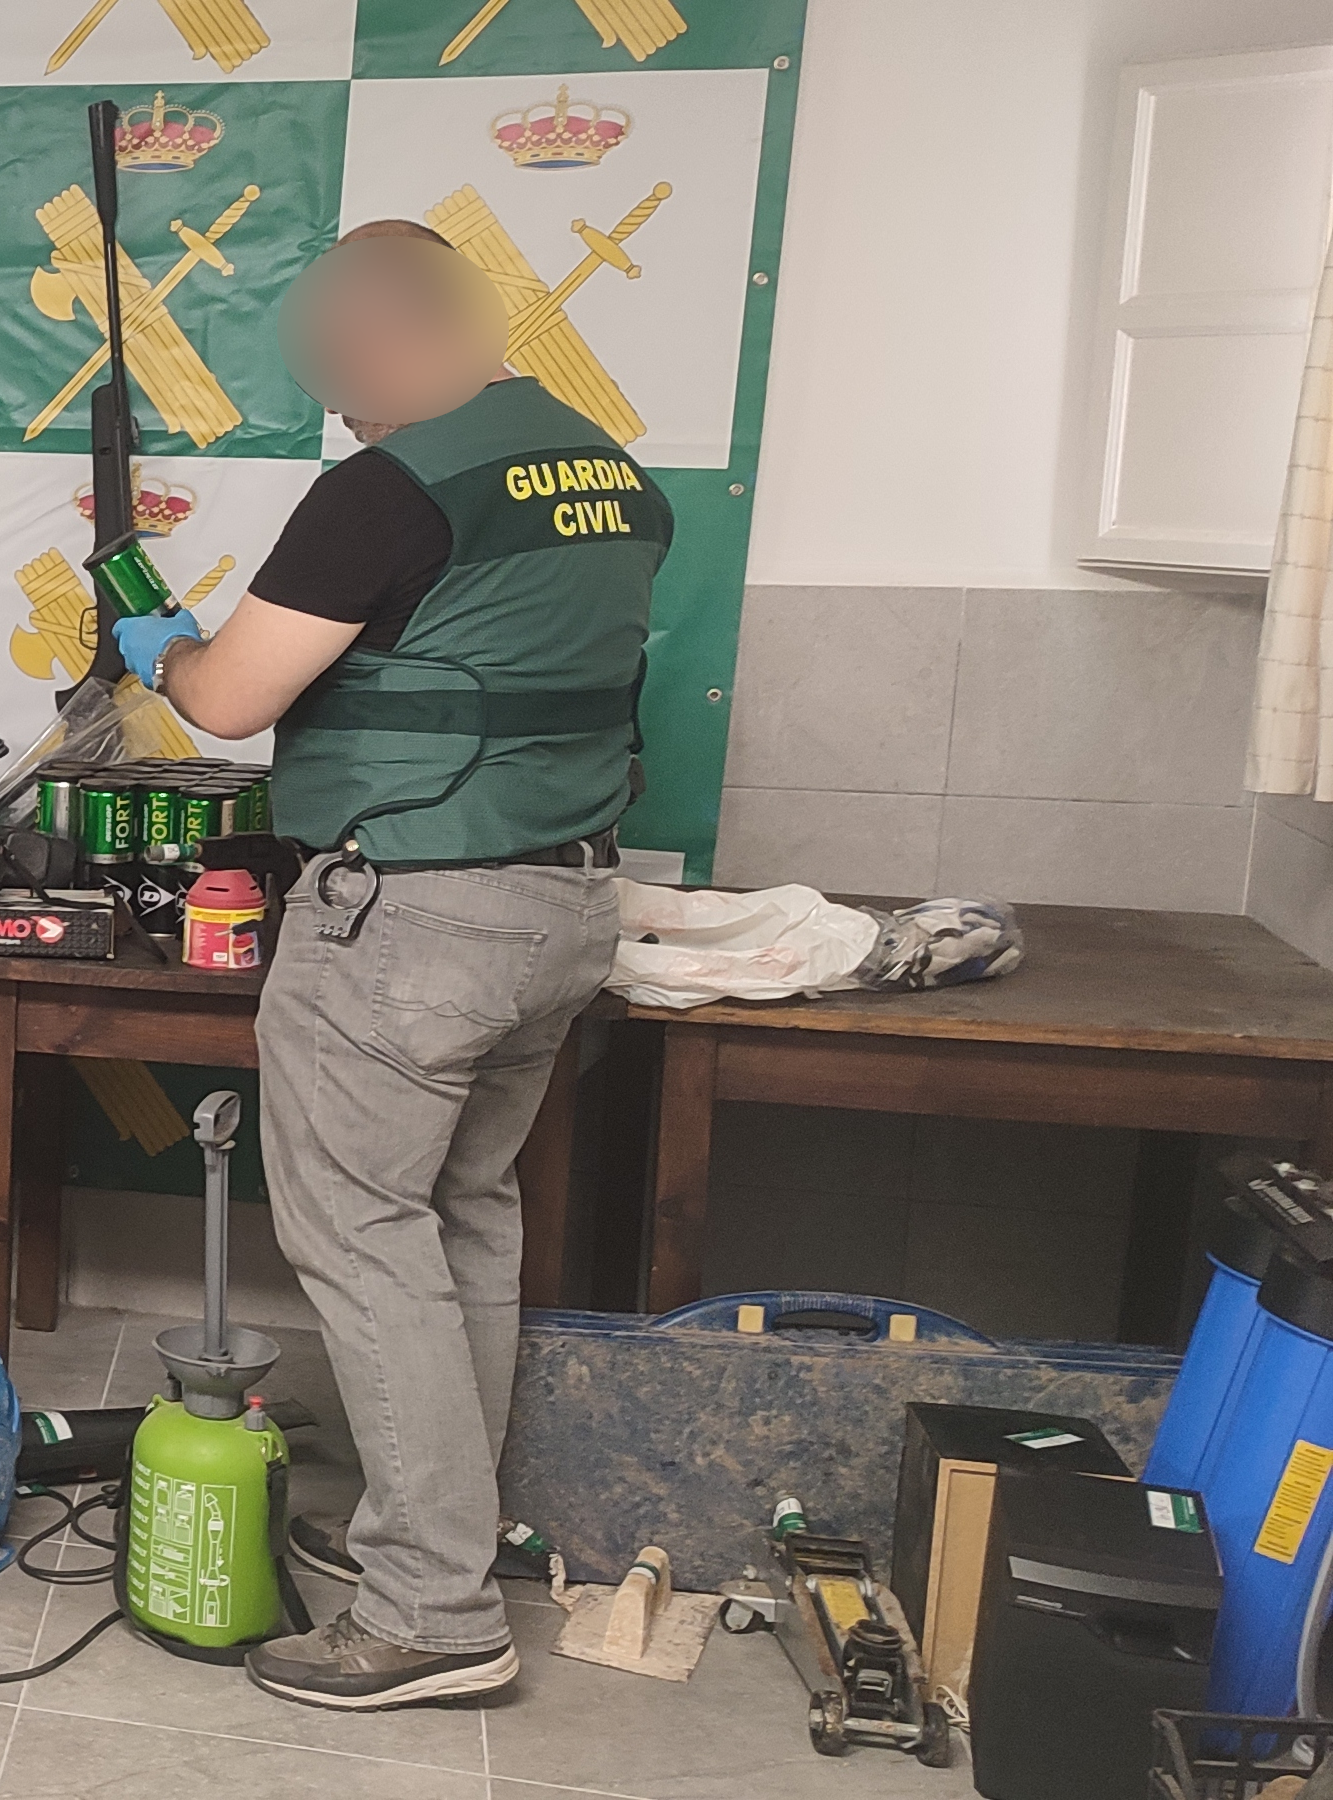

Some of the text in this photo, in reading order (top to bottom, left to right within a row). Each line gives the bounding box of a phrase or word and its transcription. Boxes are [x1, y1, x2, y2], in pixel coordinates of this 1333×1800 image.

[506, 459, 643, 500] GUARDIA
[553, 500, 631, 536] CIVIL
[115, 795, 131, 850] FORT
[186, 802, 203, 846] ORT
